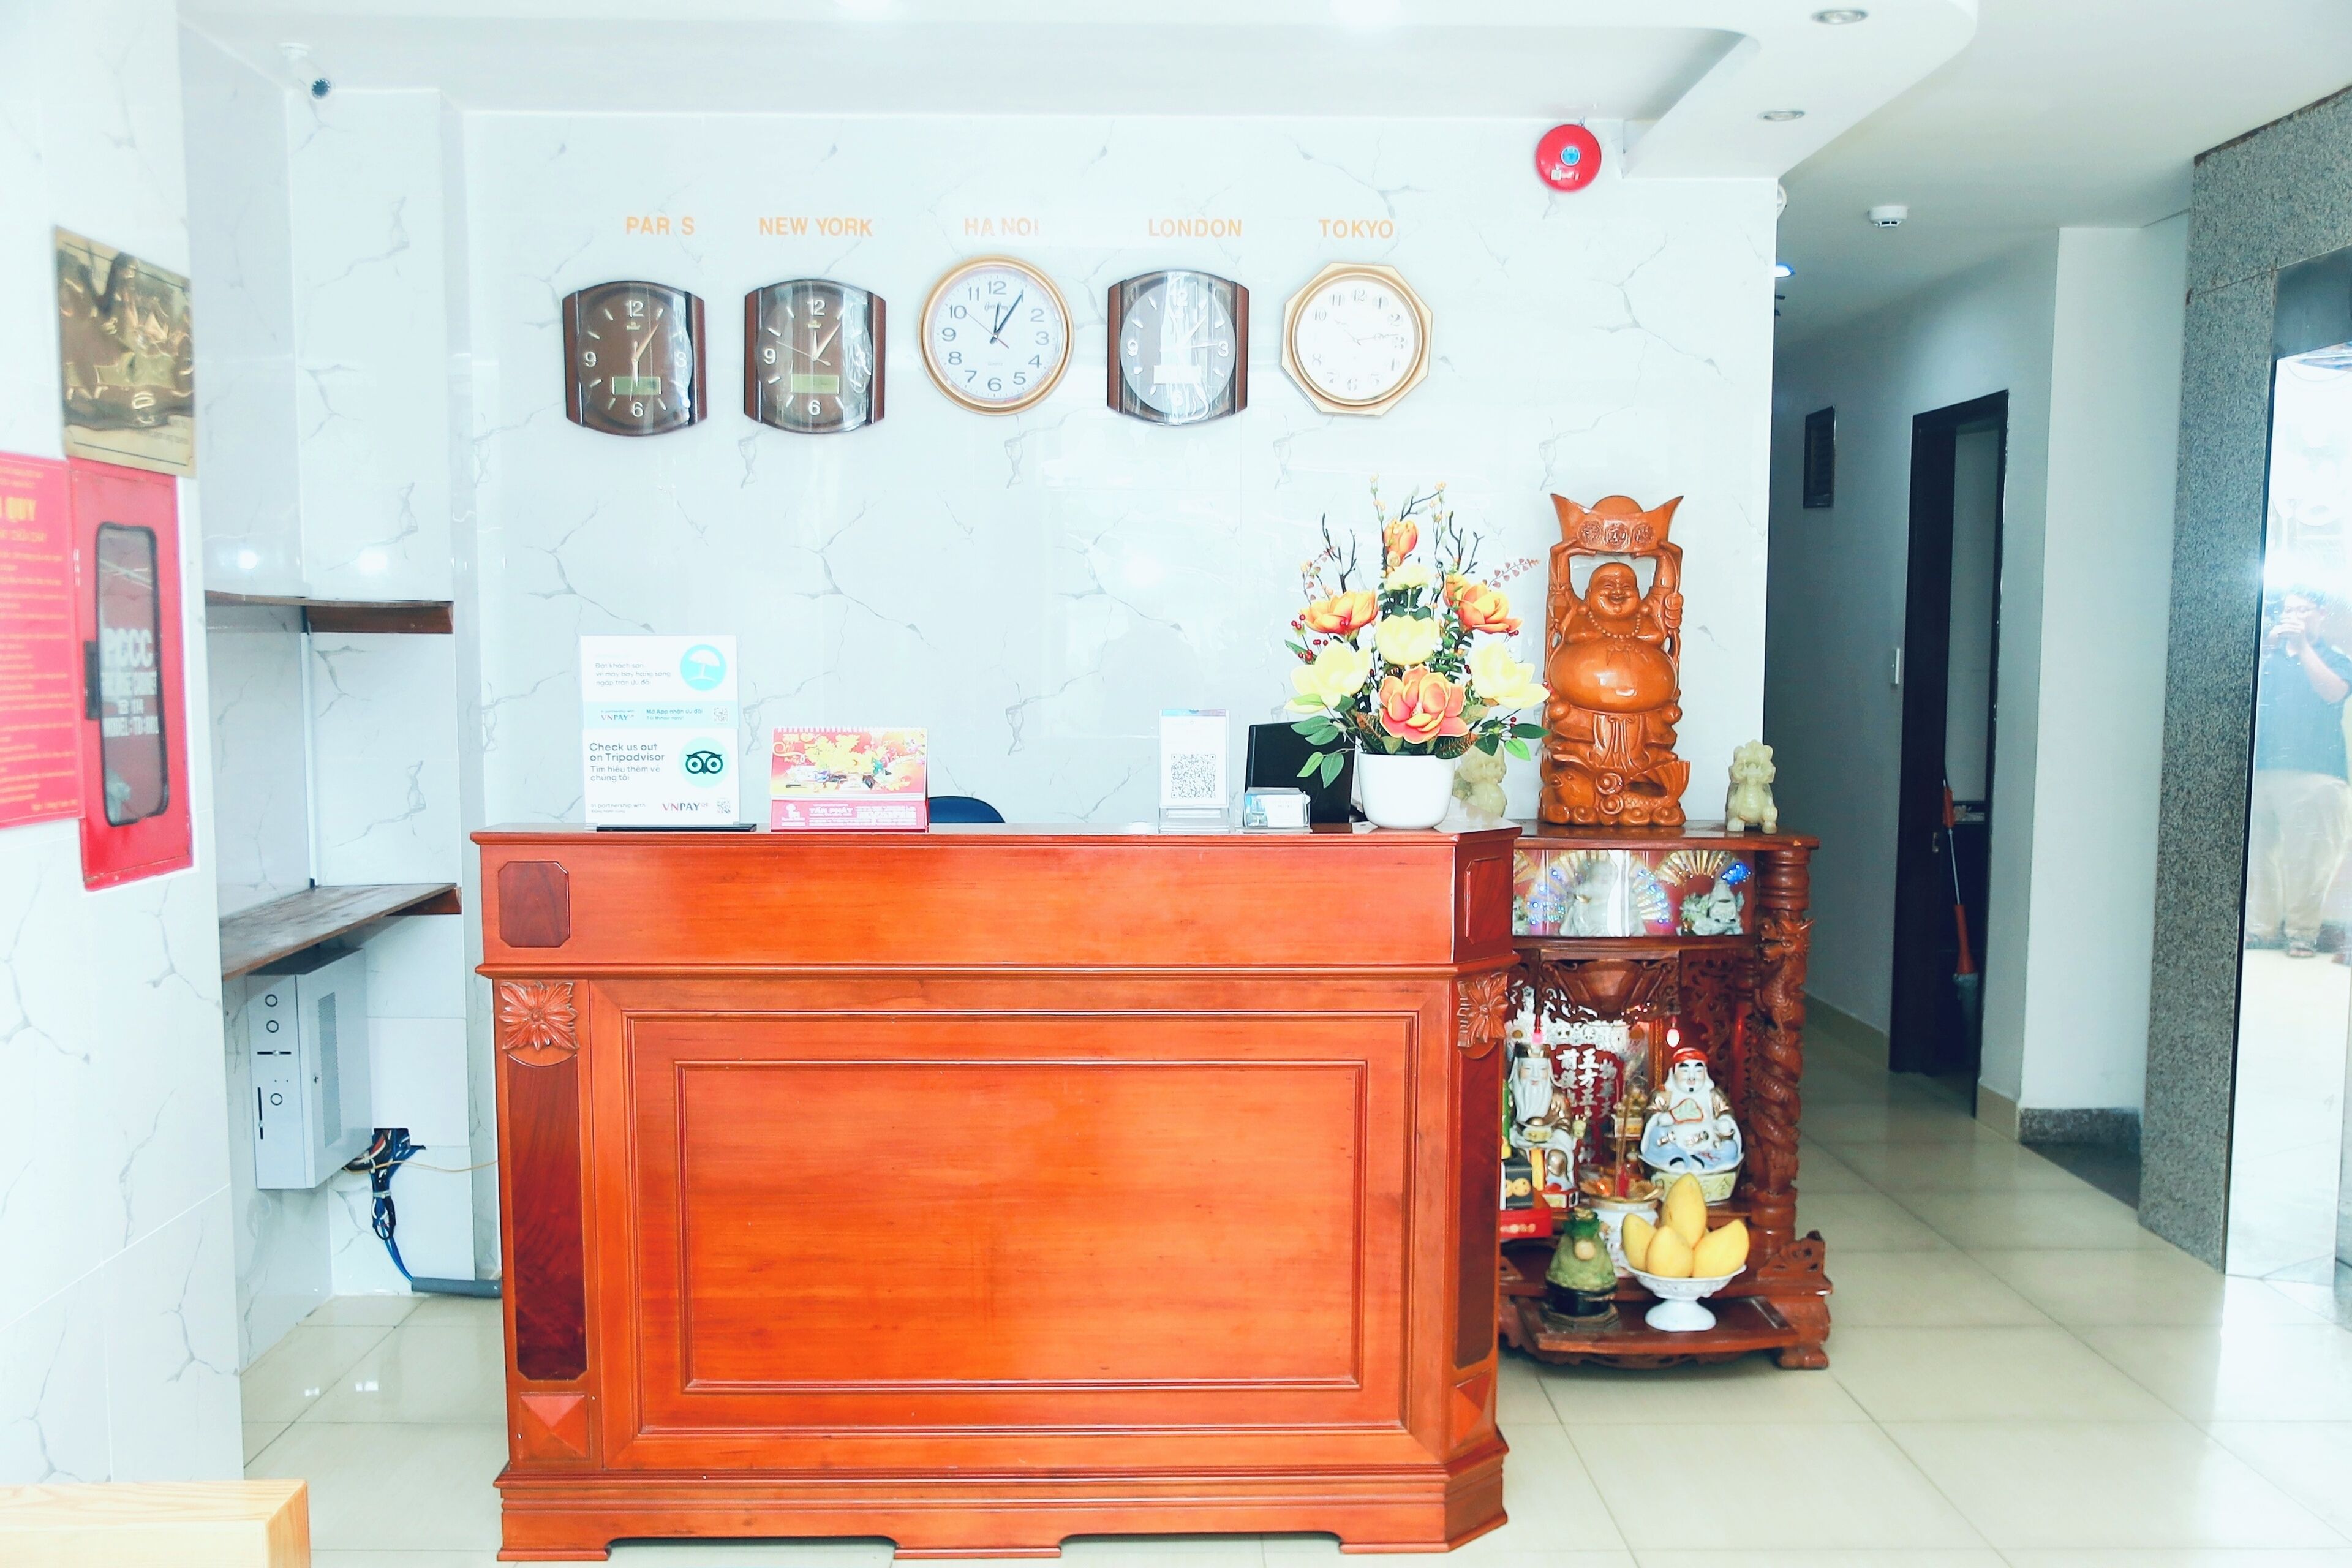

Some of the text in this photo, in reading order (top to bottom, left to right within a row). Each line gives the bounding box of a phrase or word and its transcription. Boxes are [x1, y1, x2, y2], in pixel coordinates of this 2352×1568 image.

[759, 217, 873, 237] NEW YORK
[1148, 219, 1242, 238] LONDON
[1318, 219, 1394, 239] TOKYO
[968, 287, 979, 301] 11
[988, 281, 1007, 295] 12
[1332, 294, 1341, 306] 11
[1353, 289, 1366, 302] 12
[1378, 296, 1382, 309] 1
[626, 300, 644, 317] 12
[807, 299, 826, 315] 12
[949, 305, 967, 319] 10
[1030, 308, 1044, 322] 2
[1314, 309, 1327, 320] 10
[1390, 314, 1401, 327] 2
[942, 328, 956, 341] 9
[1035, 331, 1049, 345] 3
[1127, 339, 1139, 356] 9
[1217, 341, 1229, 357] 3
[1393, 337, 1404, 350] 3
[585, 352, 597, 368] 9
[764, 349, 776, 364] 9
[948, 351, 962, 365] 8
[1028, 354, 1042, 368] 4
[1312, 353, 1322, 366] 8
[965, 370, 977, 383] 7
[1013, 372, 1026, 385] 5
[987, 378, 1002, 391] 6
[1348, 378, 1358, 391] 6
[631, 401, 644, 417] 6
[809, 399, 821, 415] 6
[102, 628, 153, 668] PCCC
[589, 742, 624, 751] Check
[605, 753, 665, 763] Tripadvisor
[662, 802, 700, 811] VNPAY
